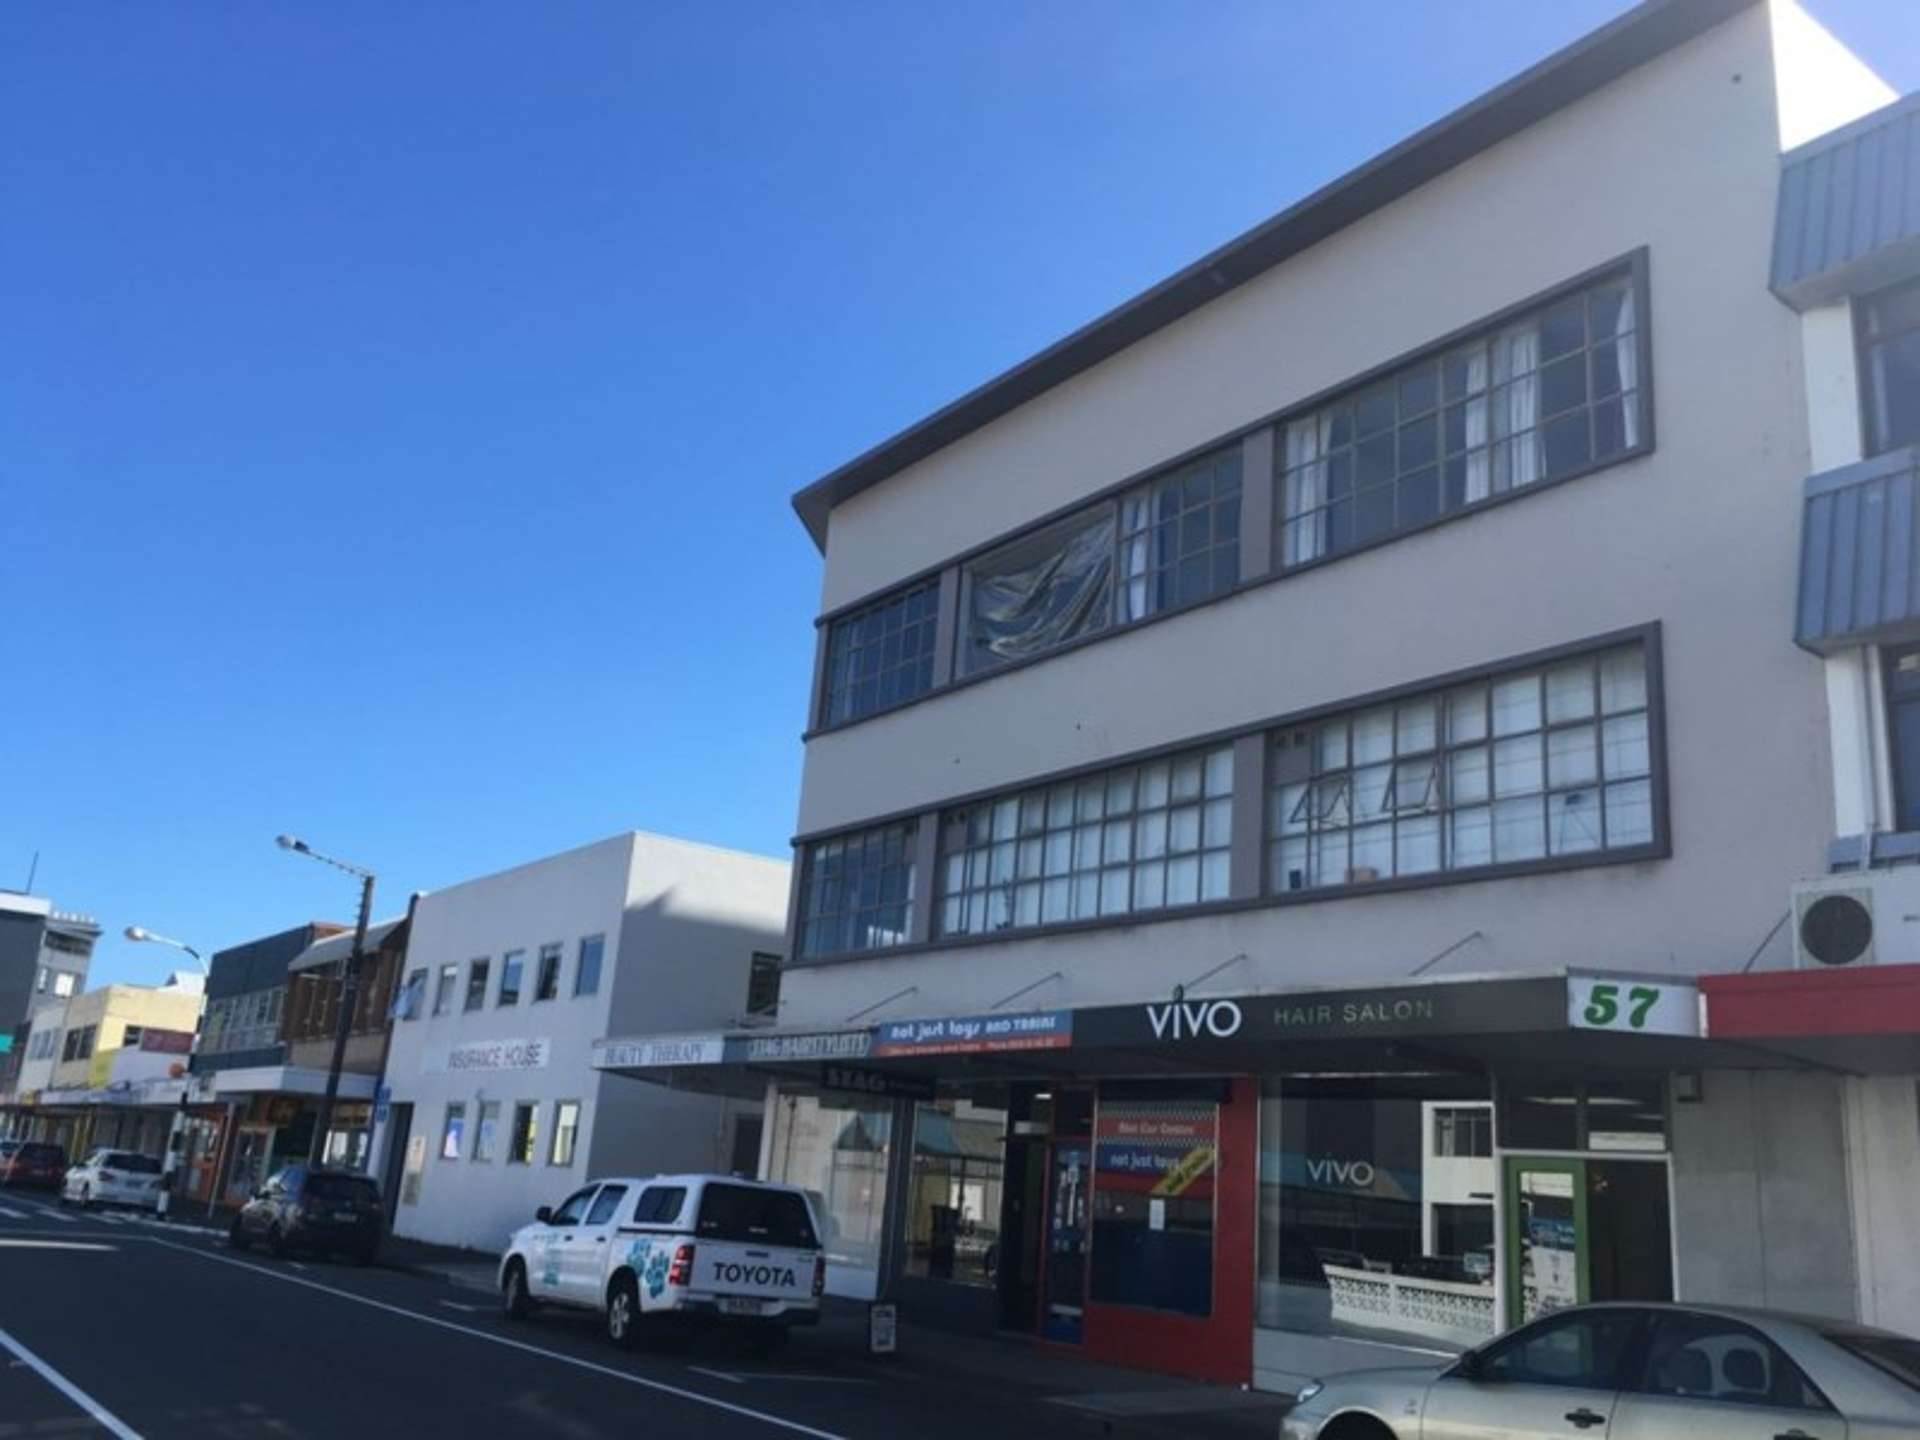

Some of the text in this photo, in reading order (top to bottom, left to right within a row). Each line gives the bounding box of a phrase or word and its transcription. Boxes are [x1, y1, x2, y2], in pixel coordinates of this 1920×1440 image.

[1274, 1001, 1434, 1026] HAIR SALON
[1582, 983, 1660, 1028] 57
[891, 1024, 914, 1039] not
[917, 1022, 944, 1042] just
[950, 1020, 980, 1039] toys
[1146, 1002, 1243, 1040] VIVO
[504, 1043, 541, 1067] HOUSE
[651, 1042, 706, 1062] THERAPY
[1130, 1151, 1153, 1171] just
[1307, 1158, 1375, 1187] VIVO
[712, 1261, 796, 1288] TOYOTA
